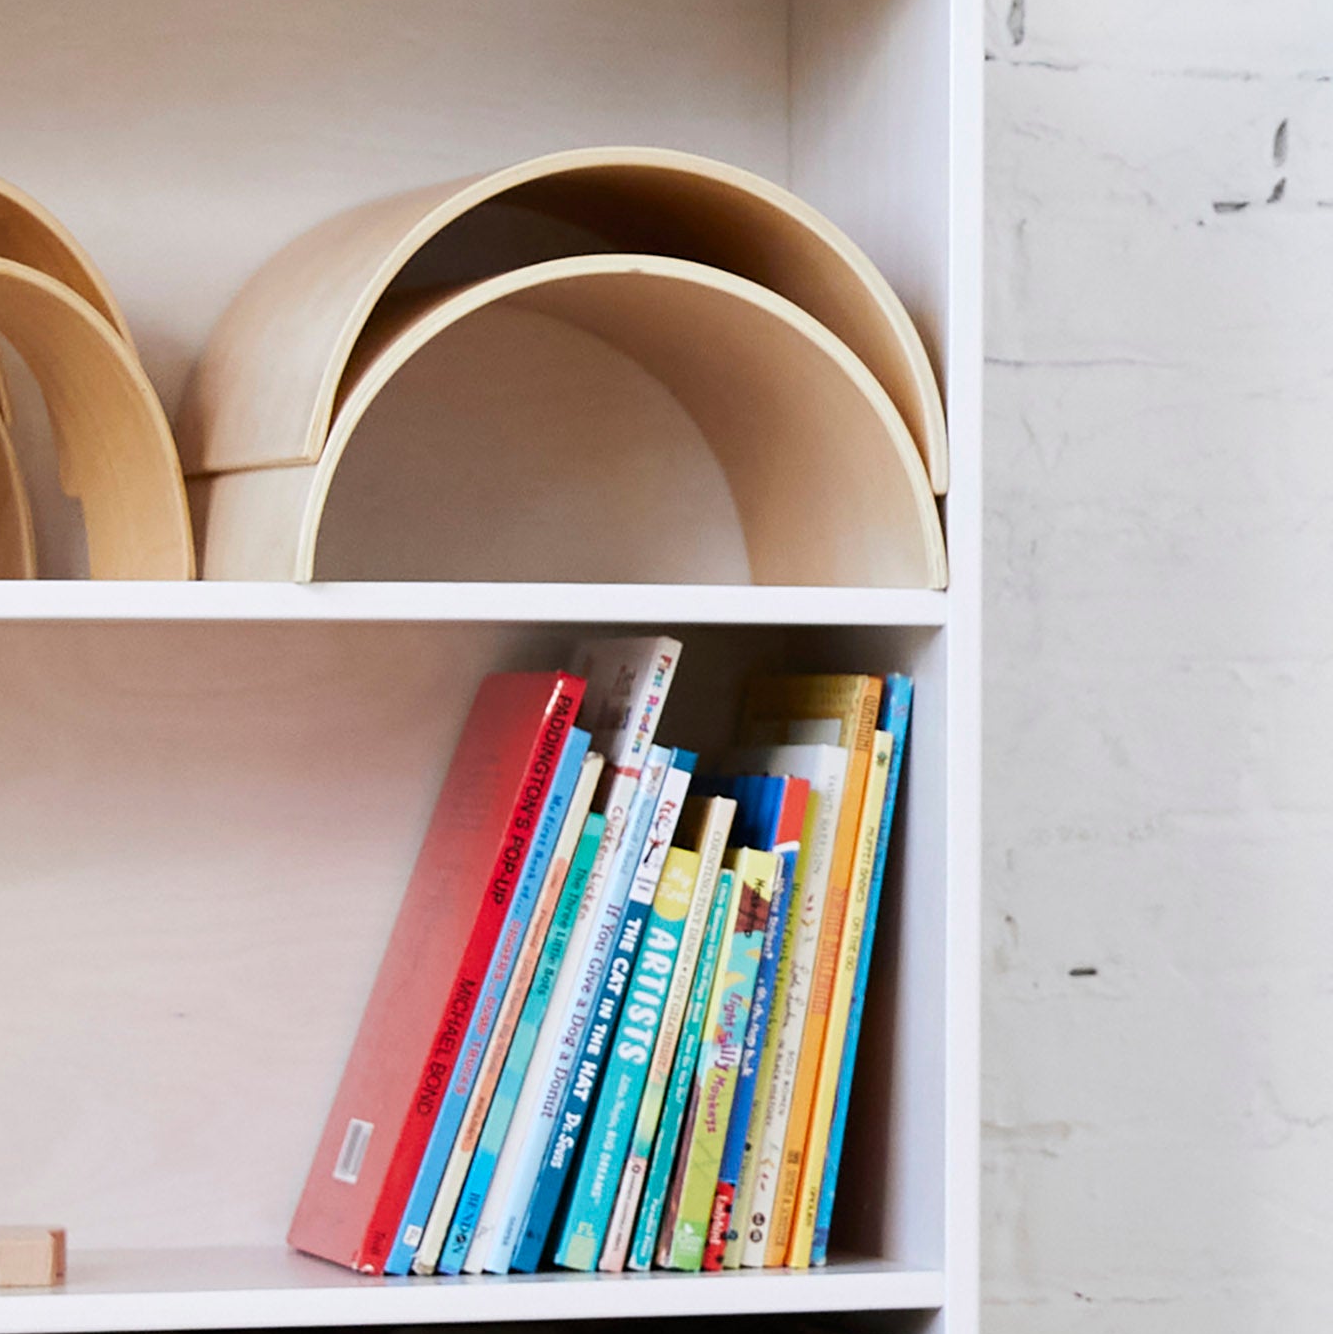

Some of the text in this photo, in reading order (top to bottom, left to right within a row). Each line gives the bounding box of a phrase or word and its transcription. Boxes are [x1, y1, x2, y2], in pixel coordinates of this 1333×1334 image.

[630, 653, 673, 756] First Readers
[513, 694, 573, 831] PADDINGTON'S
[537, 814, 556, 847] First
[488, 834, 525, 905] POP-UP
[570, 866, 587, 891] The
[576, 804, 625, 922] Chicken-Licken
[698, 829, 723, 894] COUNTING
[557, 892, 579, 930] Three
[691, 896, 707, 925] TINY
[546, 930, 567, 966] Little
[536, 965, 556, 997] Bots
[539, 902, 621, 1119] If You Give a Dog a Donut
[570, 915, 642, 1102] THE CAT IN THE HAT
[613, 925, 680, 1066] ARTISTS
[672, 974, 688, 1001] GUY
[719, 990, 744, 1027] Eight
[414, 977, 476, 1117] MICHAEL BOND
[453, 1038, 483, 1096] TRUCKS
[700, 1073, 727, 1134] Monkeys
[548, 1109, 583, 1171] Dr. Seuss
[706, 1193, 731, 1246] Ladybird
